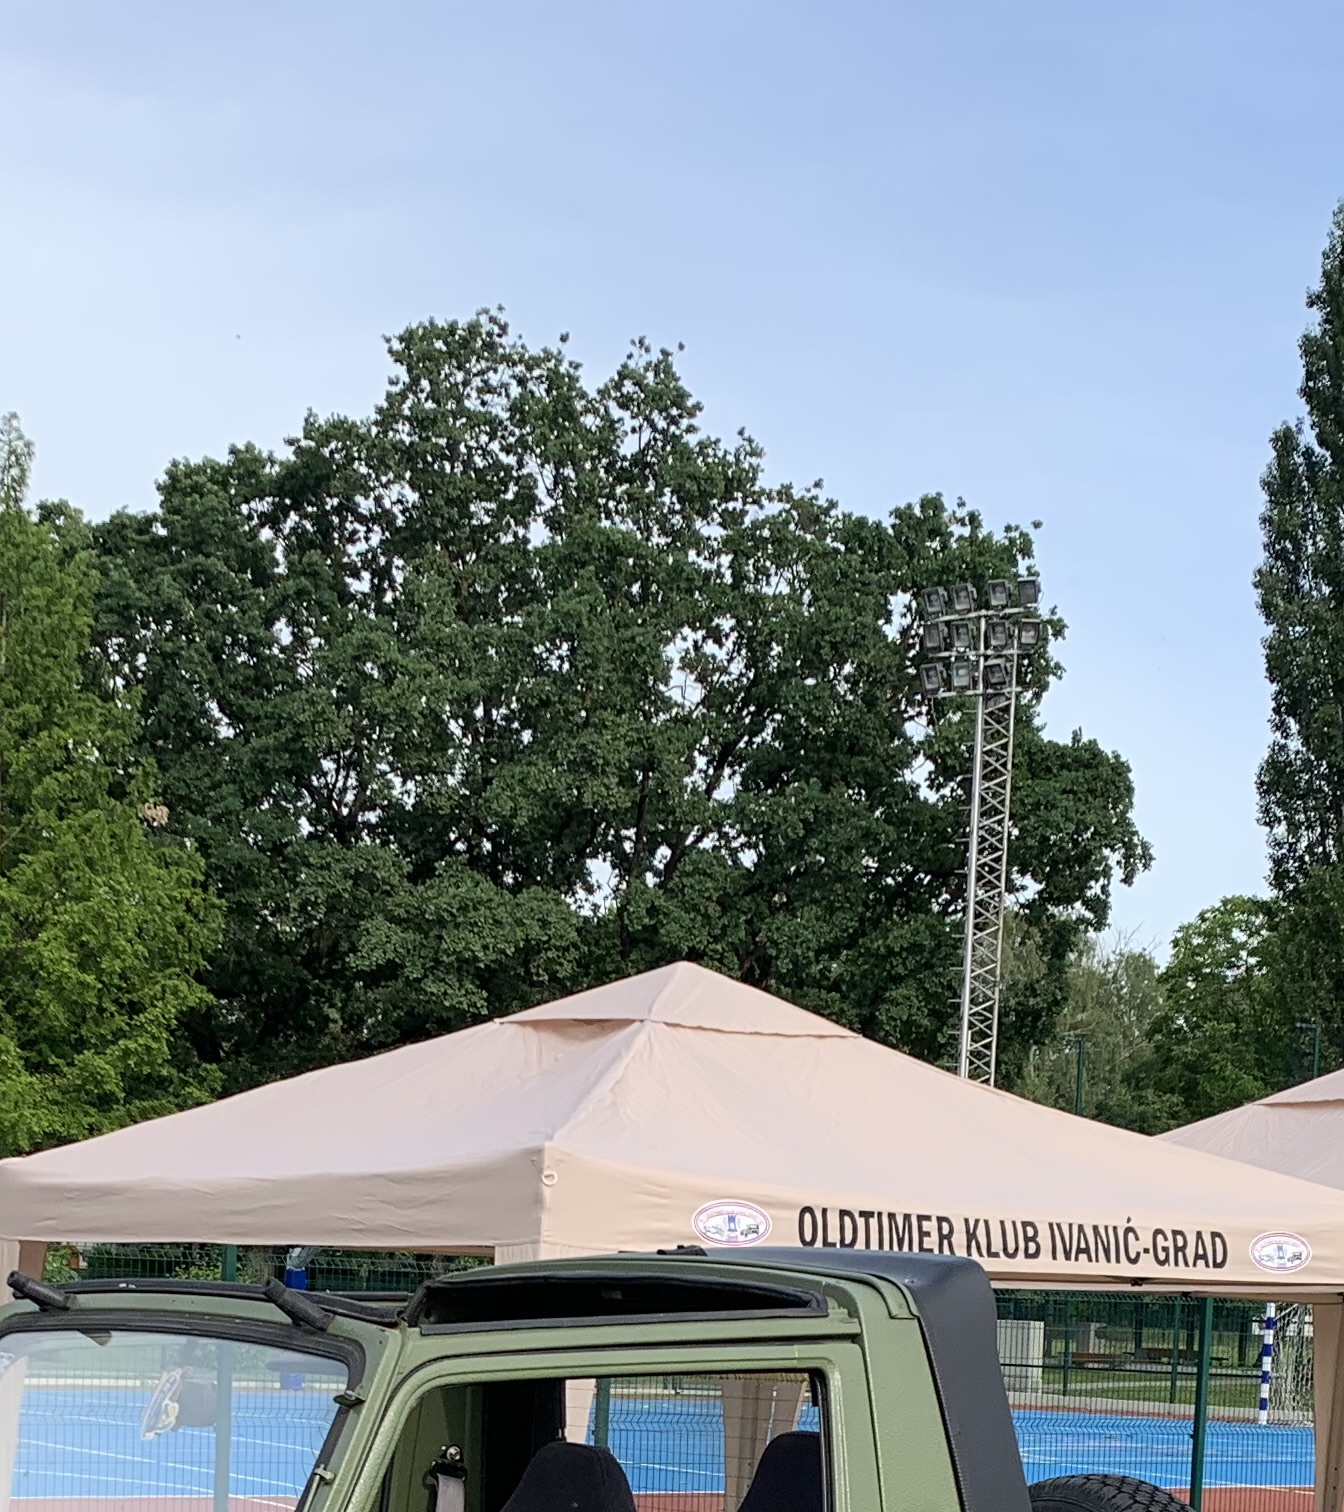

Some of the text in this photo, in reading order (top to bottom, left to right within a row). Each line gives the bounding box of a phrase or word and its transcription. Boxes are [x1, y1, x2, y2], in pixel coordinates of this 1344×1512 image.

[798, 1205, 1229, 1269] OLDTIMER KLUB IVANIĆ-GRAD
